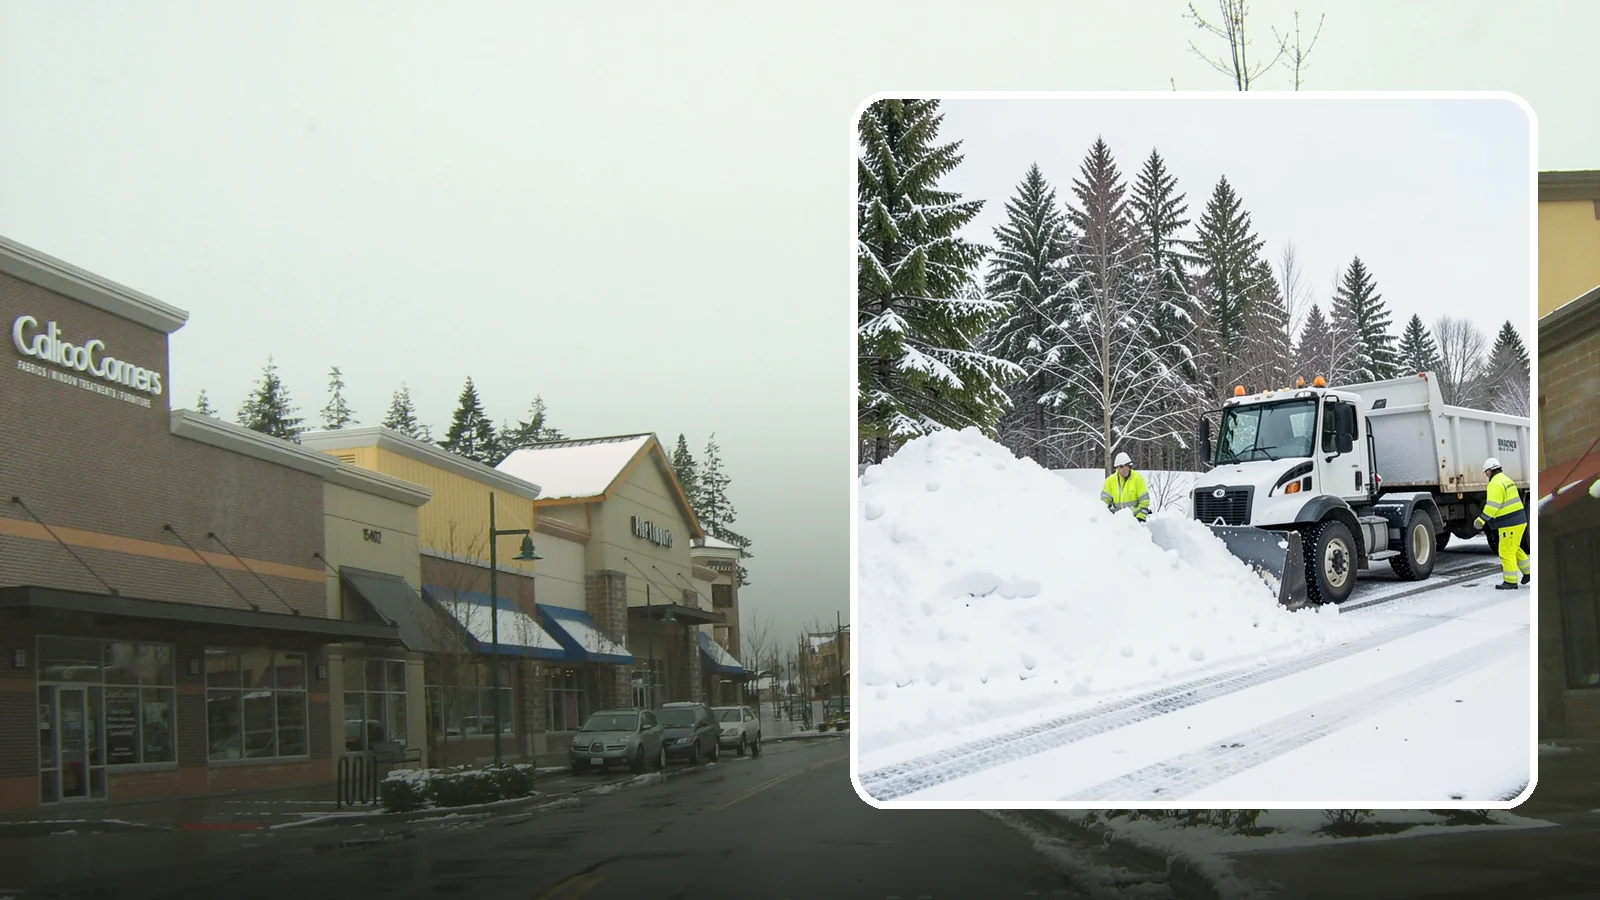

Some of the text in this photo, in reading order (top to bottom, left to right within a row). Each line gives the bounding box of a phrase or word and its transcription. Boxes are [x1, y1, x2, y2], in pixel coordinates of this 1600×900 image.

[17, 360, 151, 408] FABRICS WINDOW TREATMENTS FURNITURE
